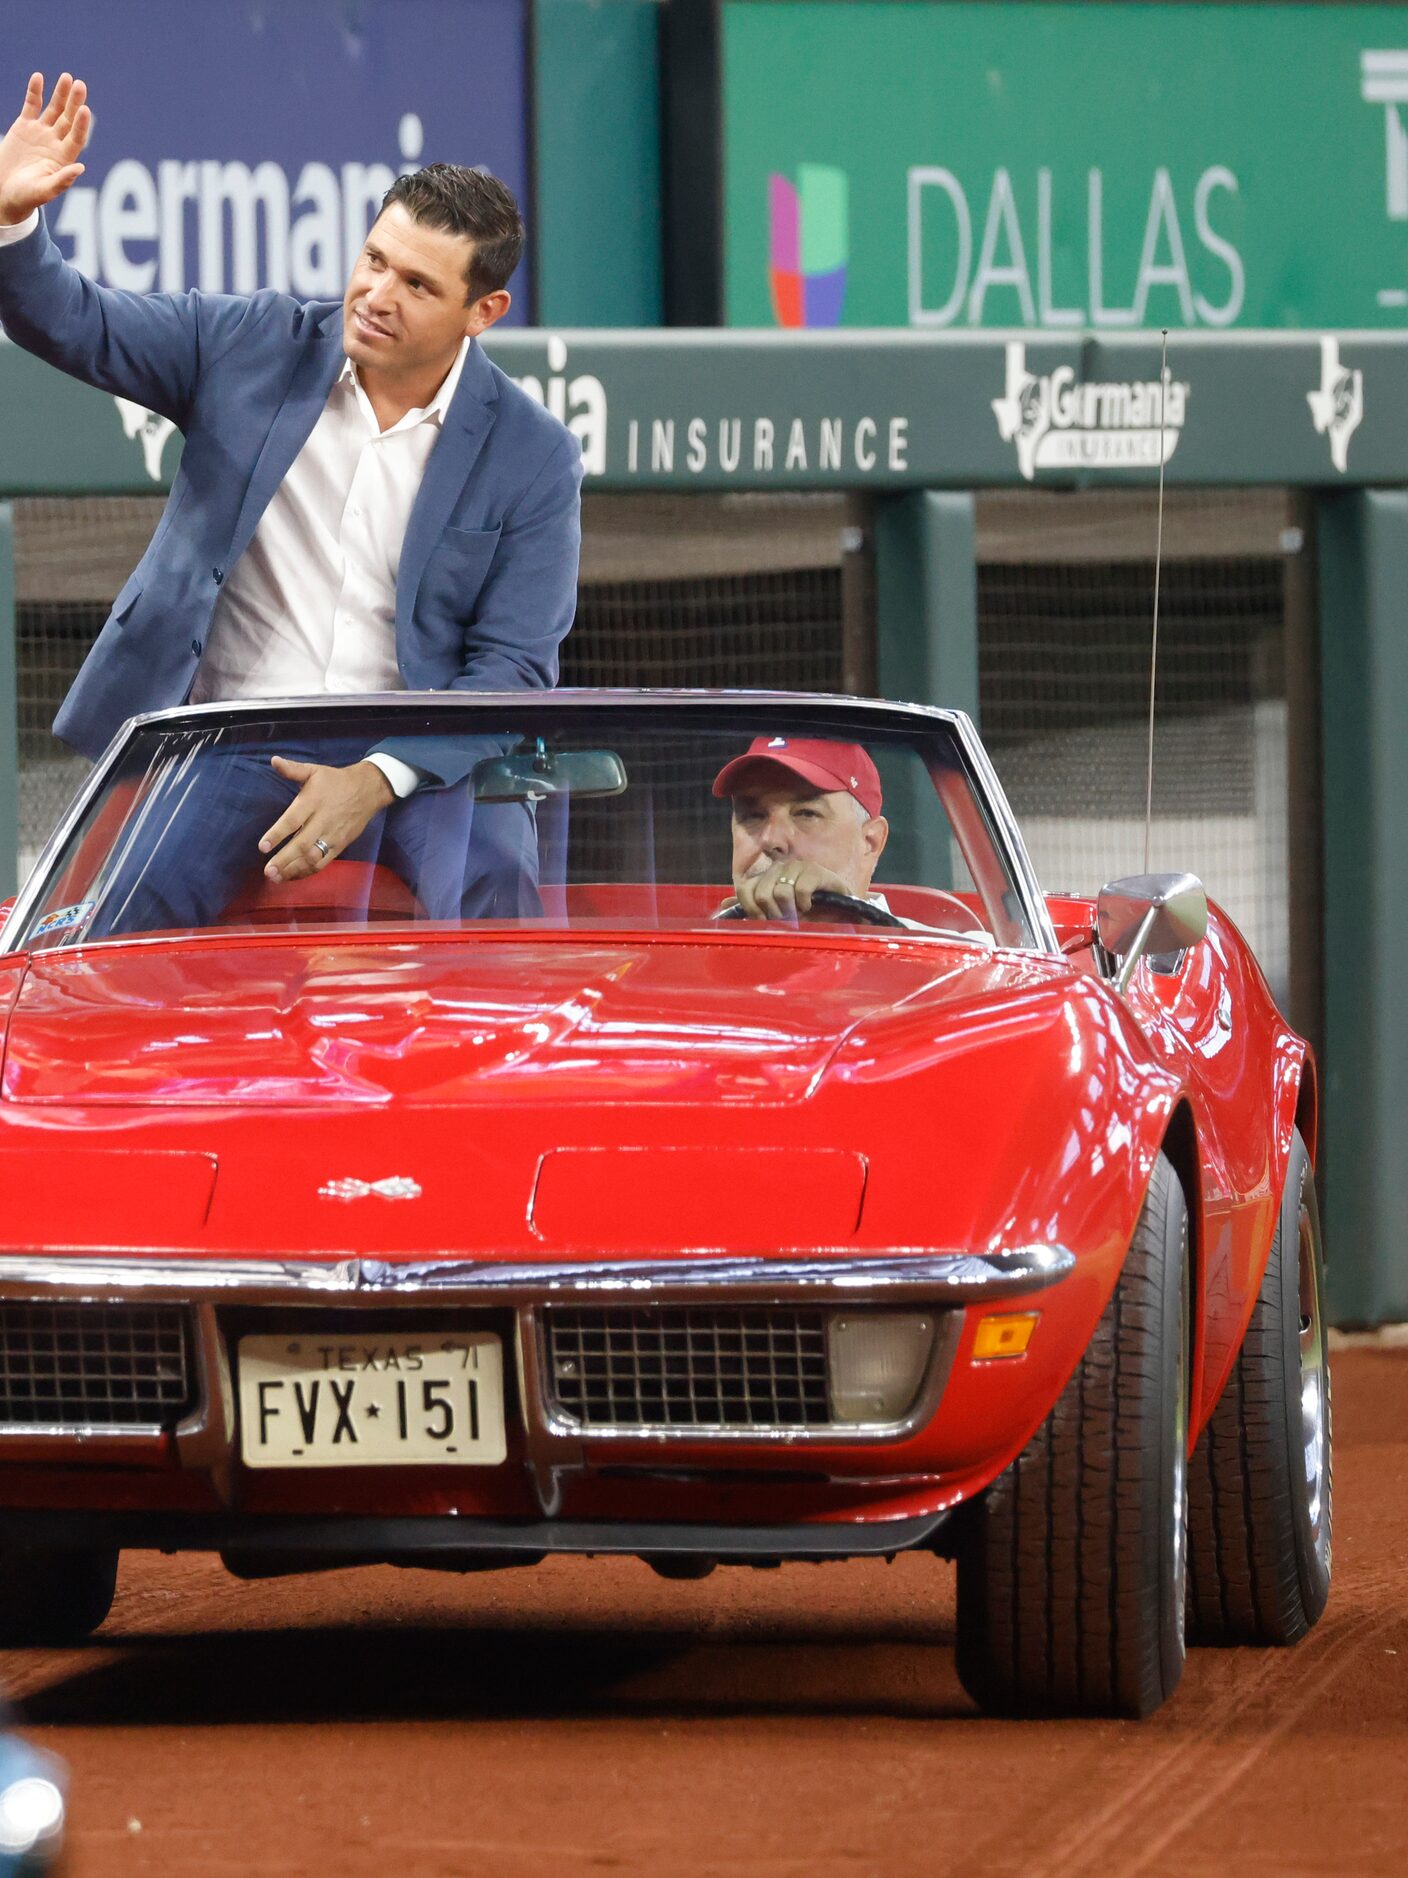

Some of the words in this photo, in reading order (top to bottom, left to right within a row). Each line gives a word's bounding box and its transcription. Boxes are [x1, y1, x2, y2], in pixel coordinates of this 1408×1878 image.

[907, 165, 1245, 327] DALLAS
[628, 417, 909, 473] INSURANCE
[319, 1344, 424, 1371] TEXAS
[258, 1379, 358, 1445] FVX
[397, 1379, 480, 1441] 151
